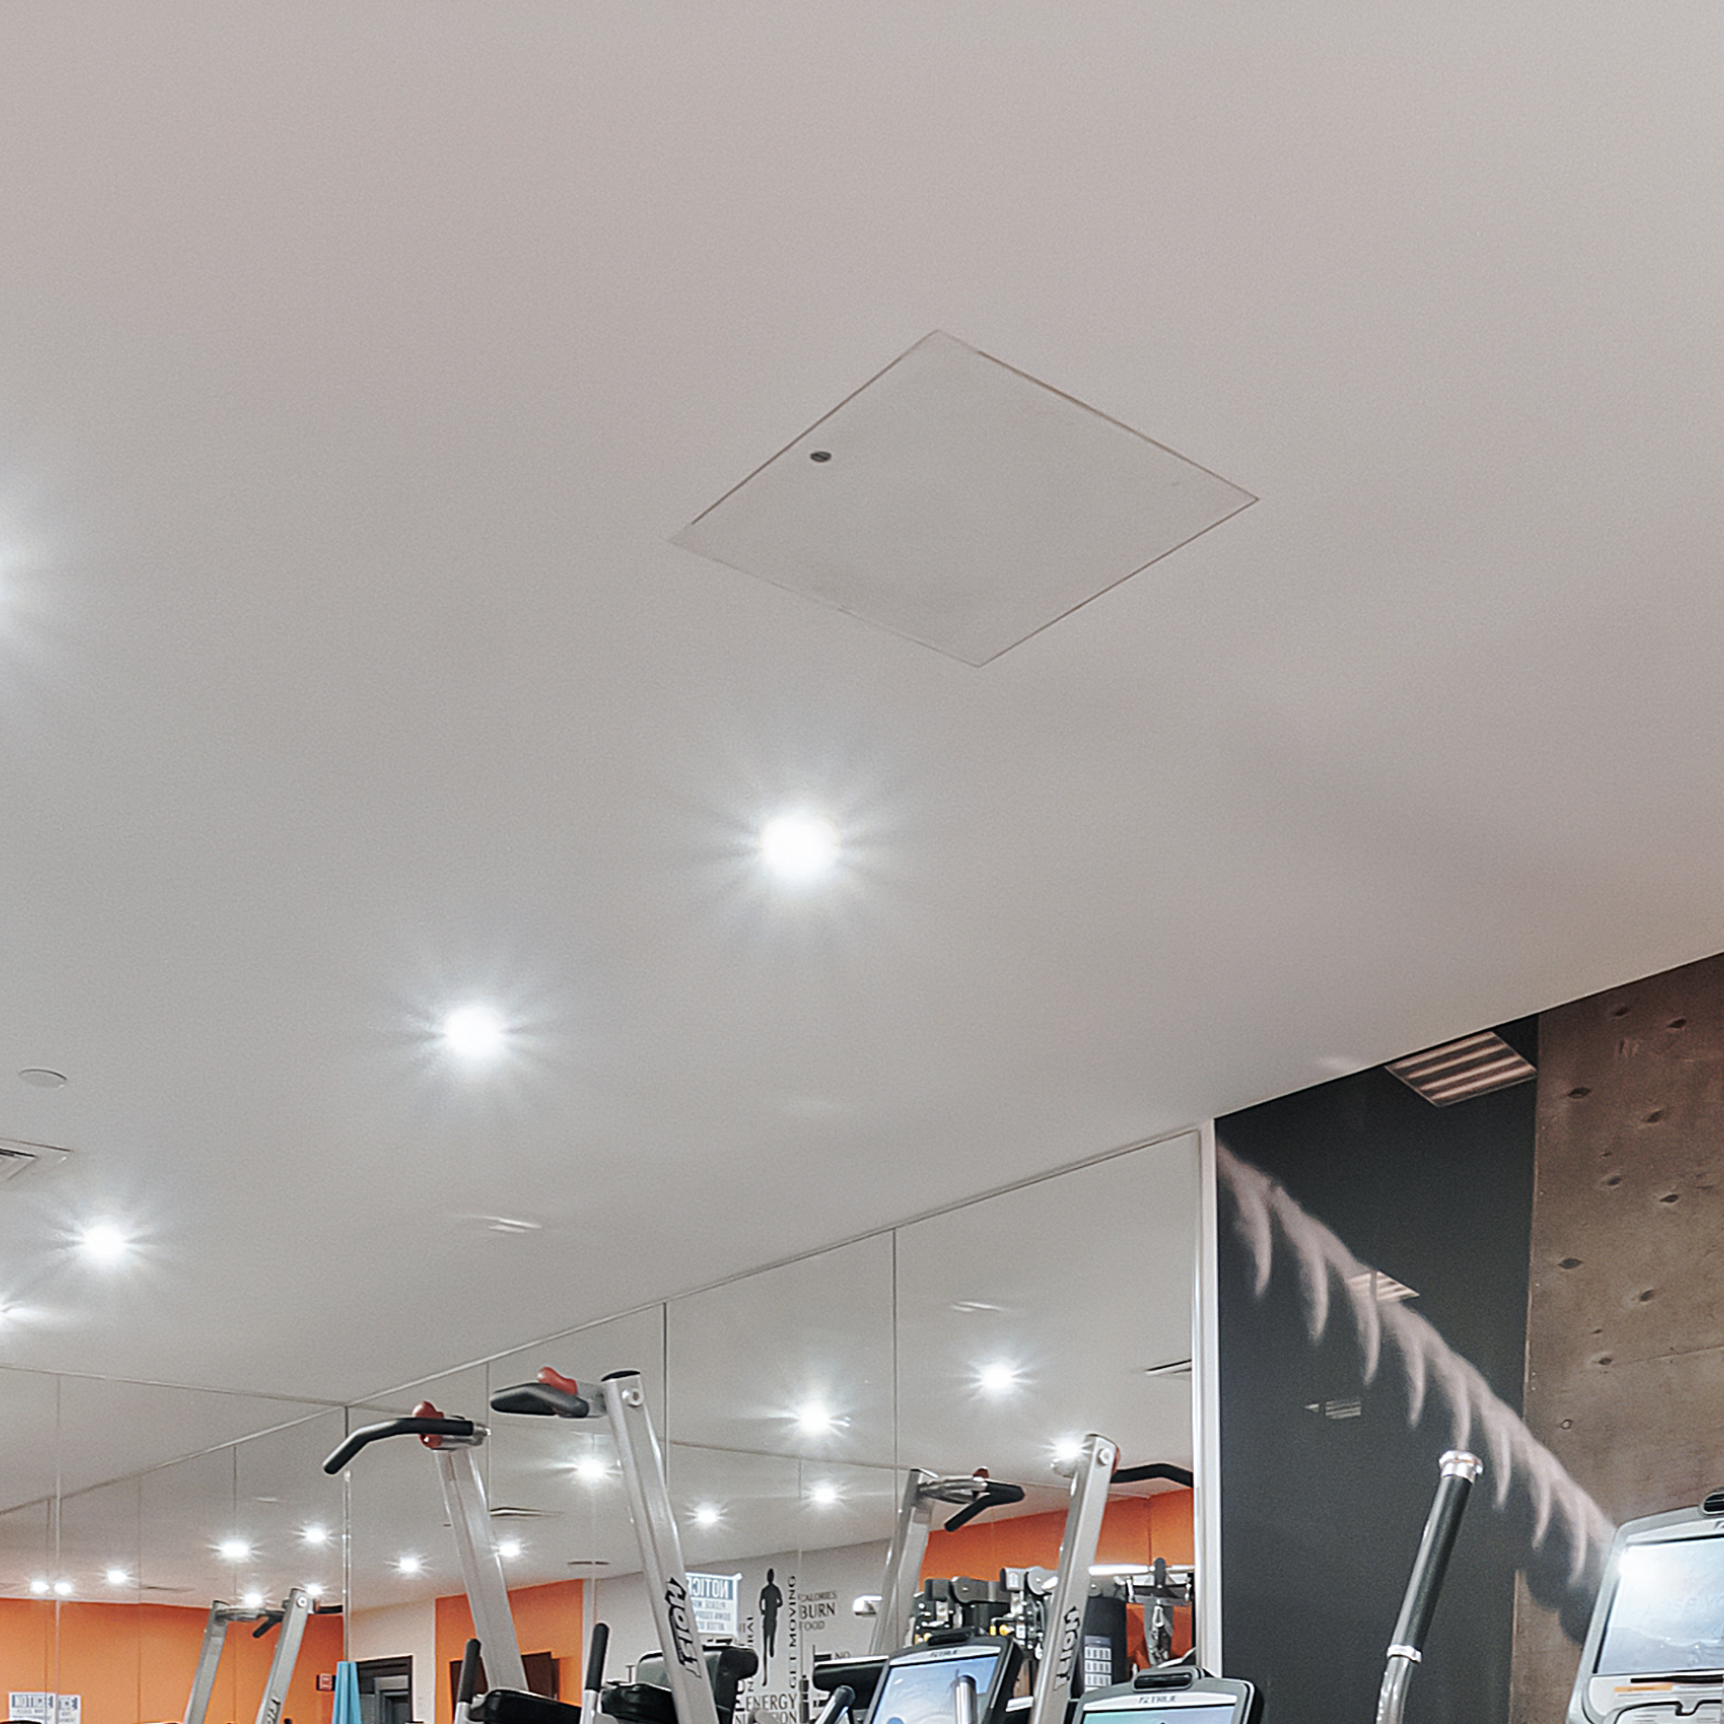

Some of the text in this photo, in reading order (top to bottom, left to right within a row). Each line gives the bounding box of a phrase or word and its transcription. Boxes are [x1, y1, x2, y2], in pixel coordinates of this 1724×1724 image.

[788, 1576, 797, 1647] MOVING
[799, 1603, 836, 1620] BURN
[746, 1694, 797, 1712] ENERGY
